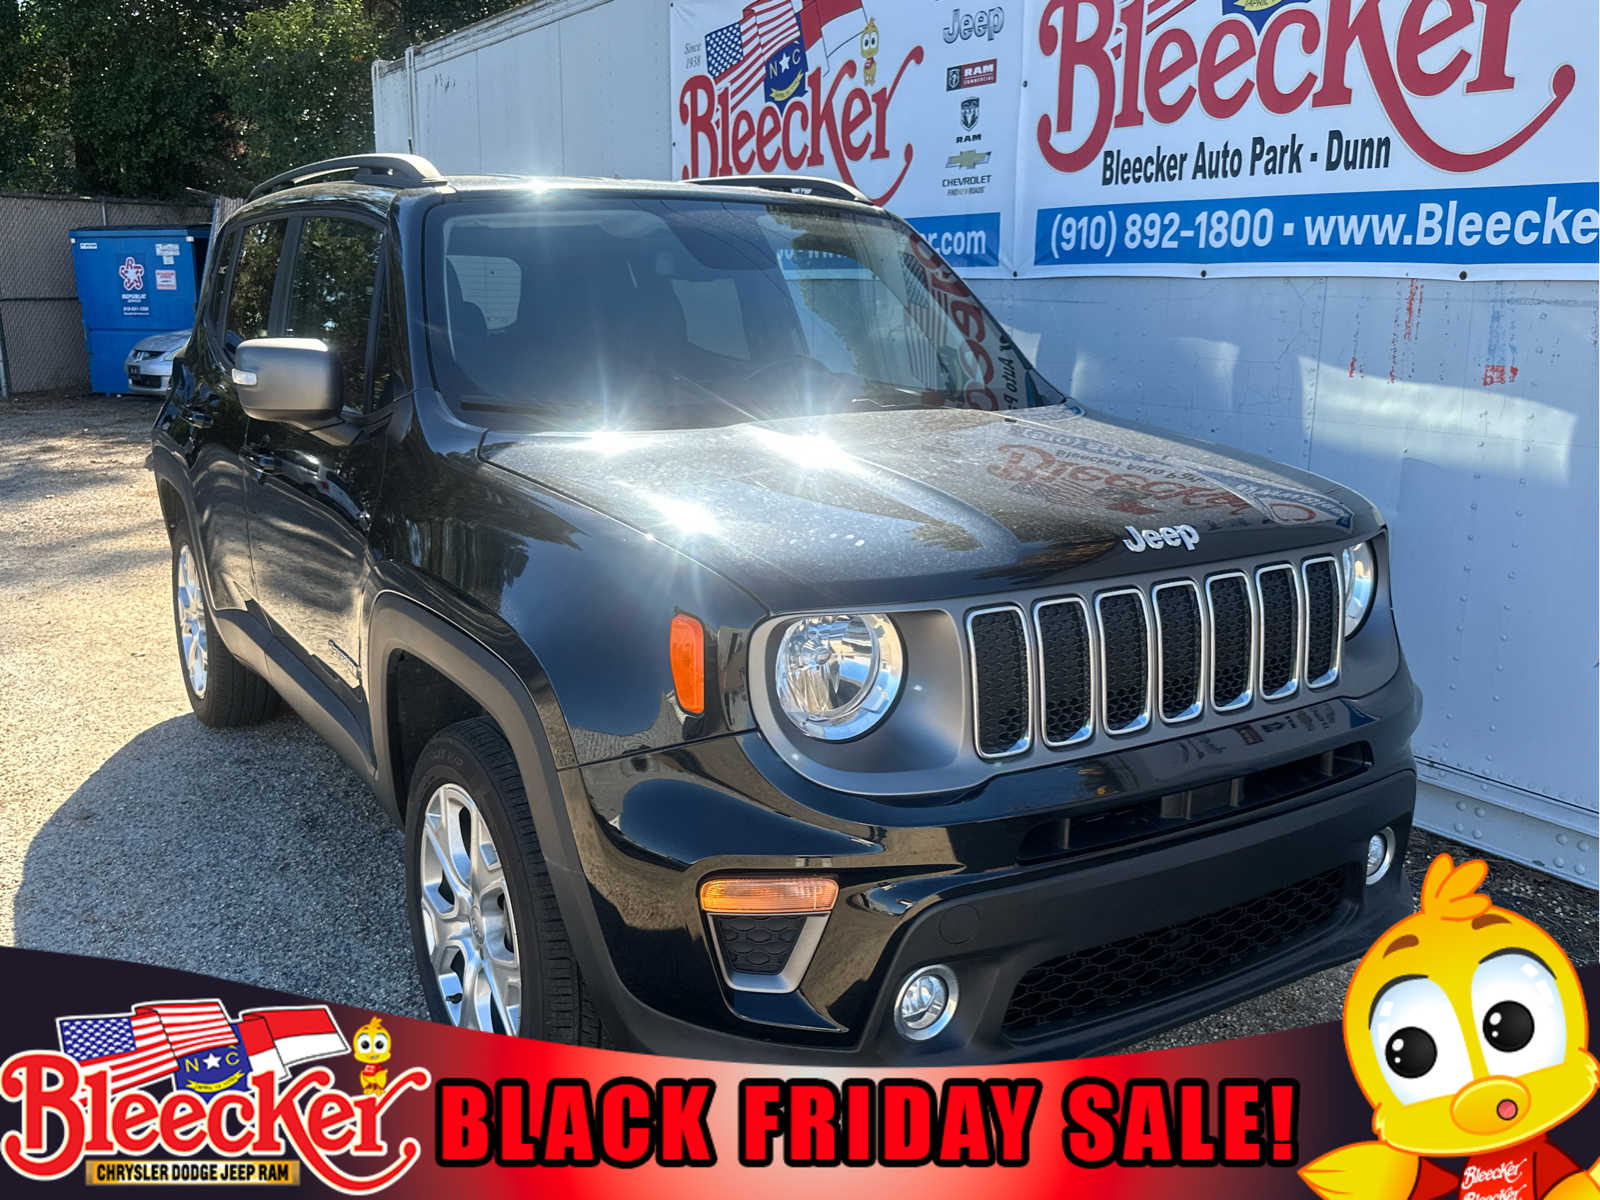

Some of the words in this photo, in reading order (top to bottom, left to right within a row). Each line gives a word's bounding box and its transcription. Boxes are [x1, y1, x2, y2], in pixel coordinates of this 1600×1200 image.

[943, 6, 1005, 44] Jeep
[963, 63, 994, 77] RAM
[1037, 0, 1576, 173] Bleecker
[679, 45, 924, 207] Bleecker
[955, 134, 982, 143] RAM
[1102, 145, 1188, 186] Bleecker
[1192, 140, 1242, 180] Auto
[1249, 133, 1304, 176] Park
[1325, 129, 1391, 171] Dunn
[942, 174, 992, 187] CHEVROLET
[920, 230, 986, 256] r.com
[1051, 210, 1117, 259] (910)
[1124, 208, 1274, 249] 892-1800
[1304, 196, 1599, 246] www.Bleecke
[1122, 524, 1200, 552] Jeep
